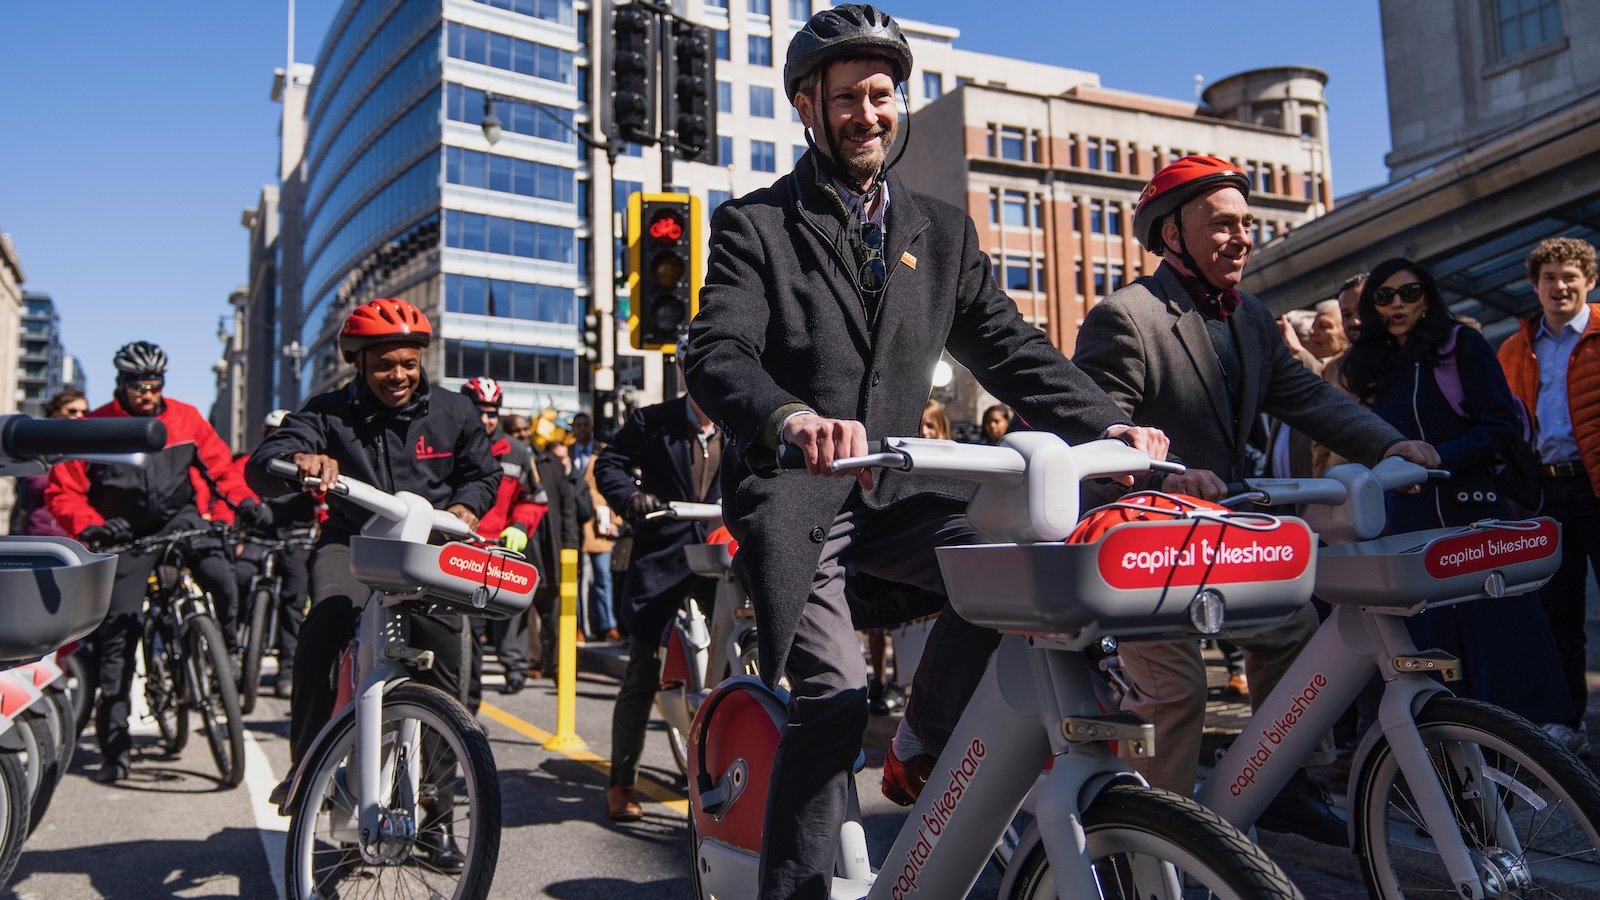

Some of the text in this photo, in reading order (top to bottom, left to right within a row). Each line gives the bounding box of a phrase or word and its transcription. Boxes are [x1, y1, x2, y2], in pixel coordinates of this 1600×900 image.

[449, 556, 485, 573] capital
[1121, 538, 1294, 574] capital bikeshare
[1440, 535, 1548, 567] capital bikeshare
[1230, 673, 1328, 797] capital bikeshare
[891, 738, 986, 900] capital bikeshare
